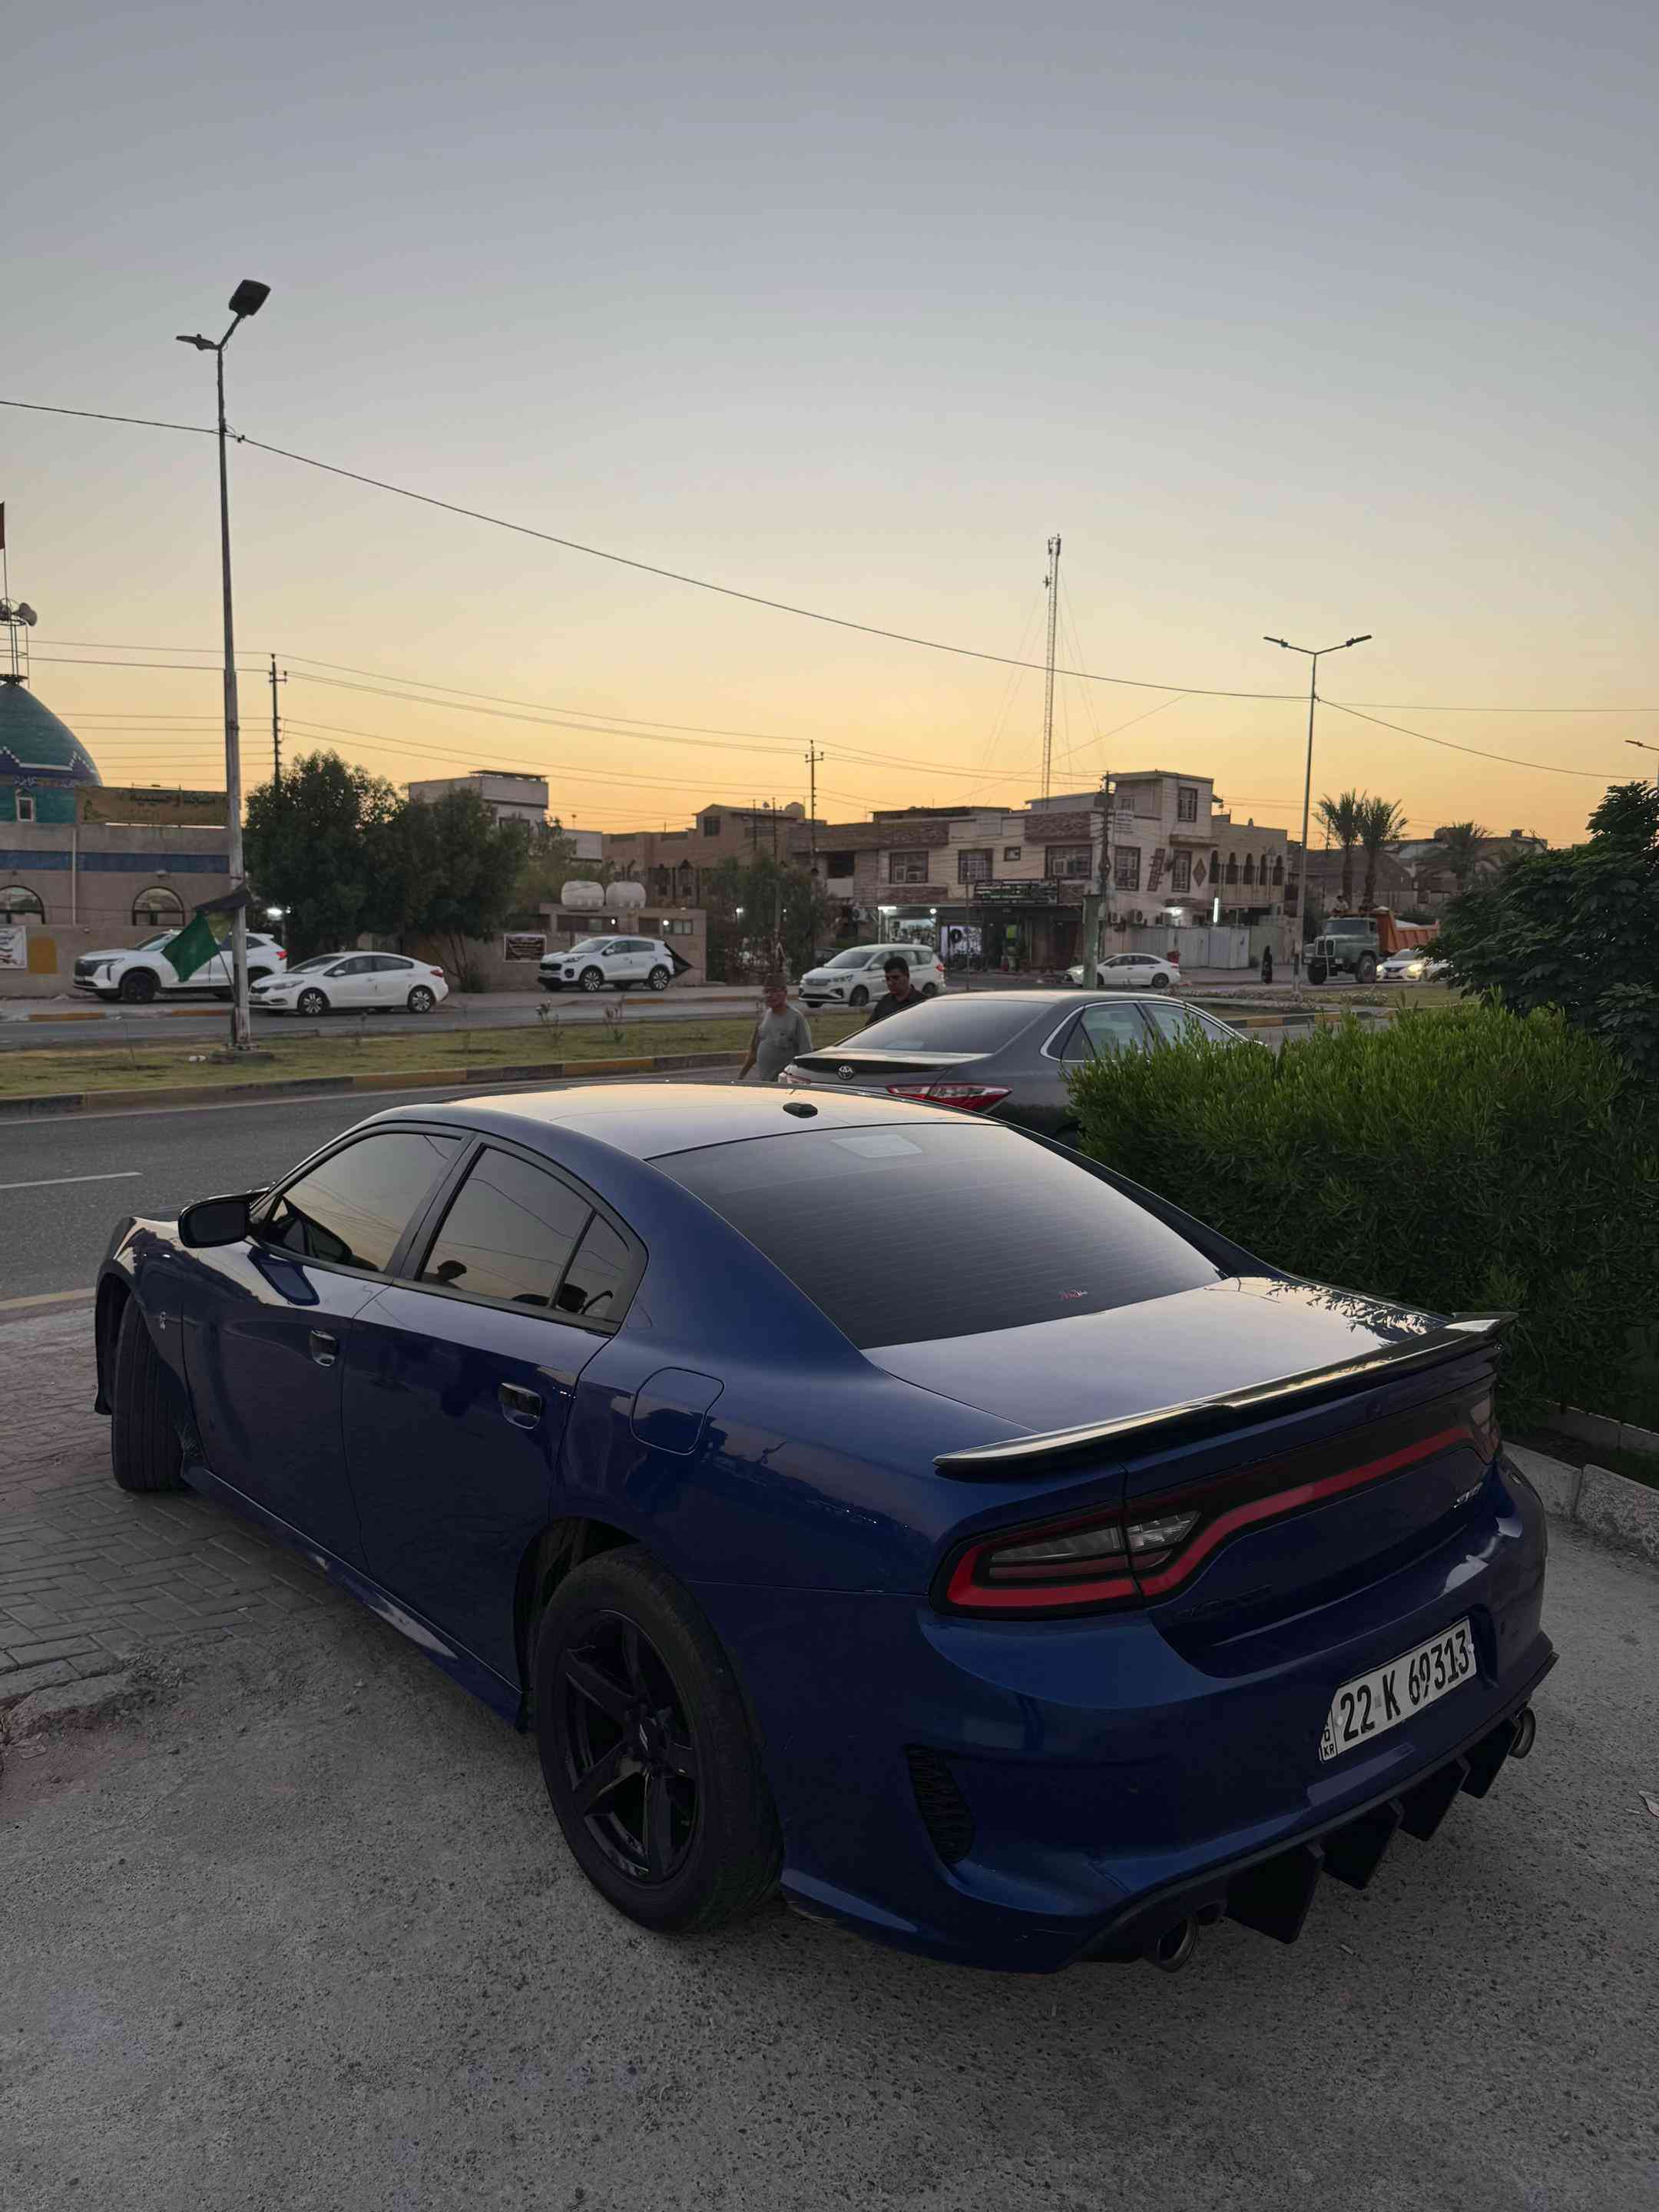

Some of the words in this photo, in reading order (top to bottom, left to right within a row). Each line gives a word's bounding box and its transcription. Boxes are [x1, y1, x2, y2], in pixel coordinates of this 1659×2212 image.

[1340, 1684, 1375, 1742] 22
[1382, 1669, 1401, 1721] K
[1409, 1628, 1469, 1706] 69313
